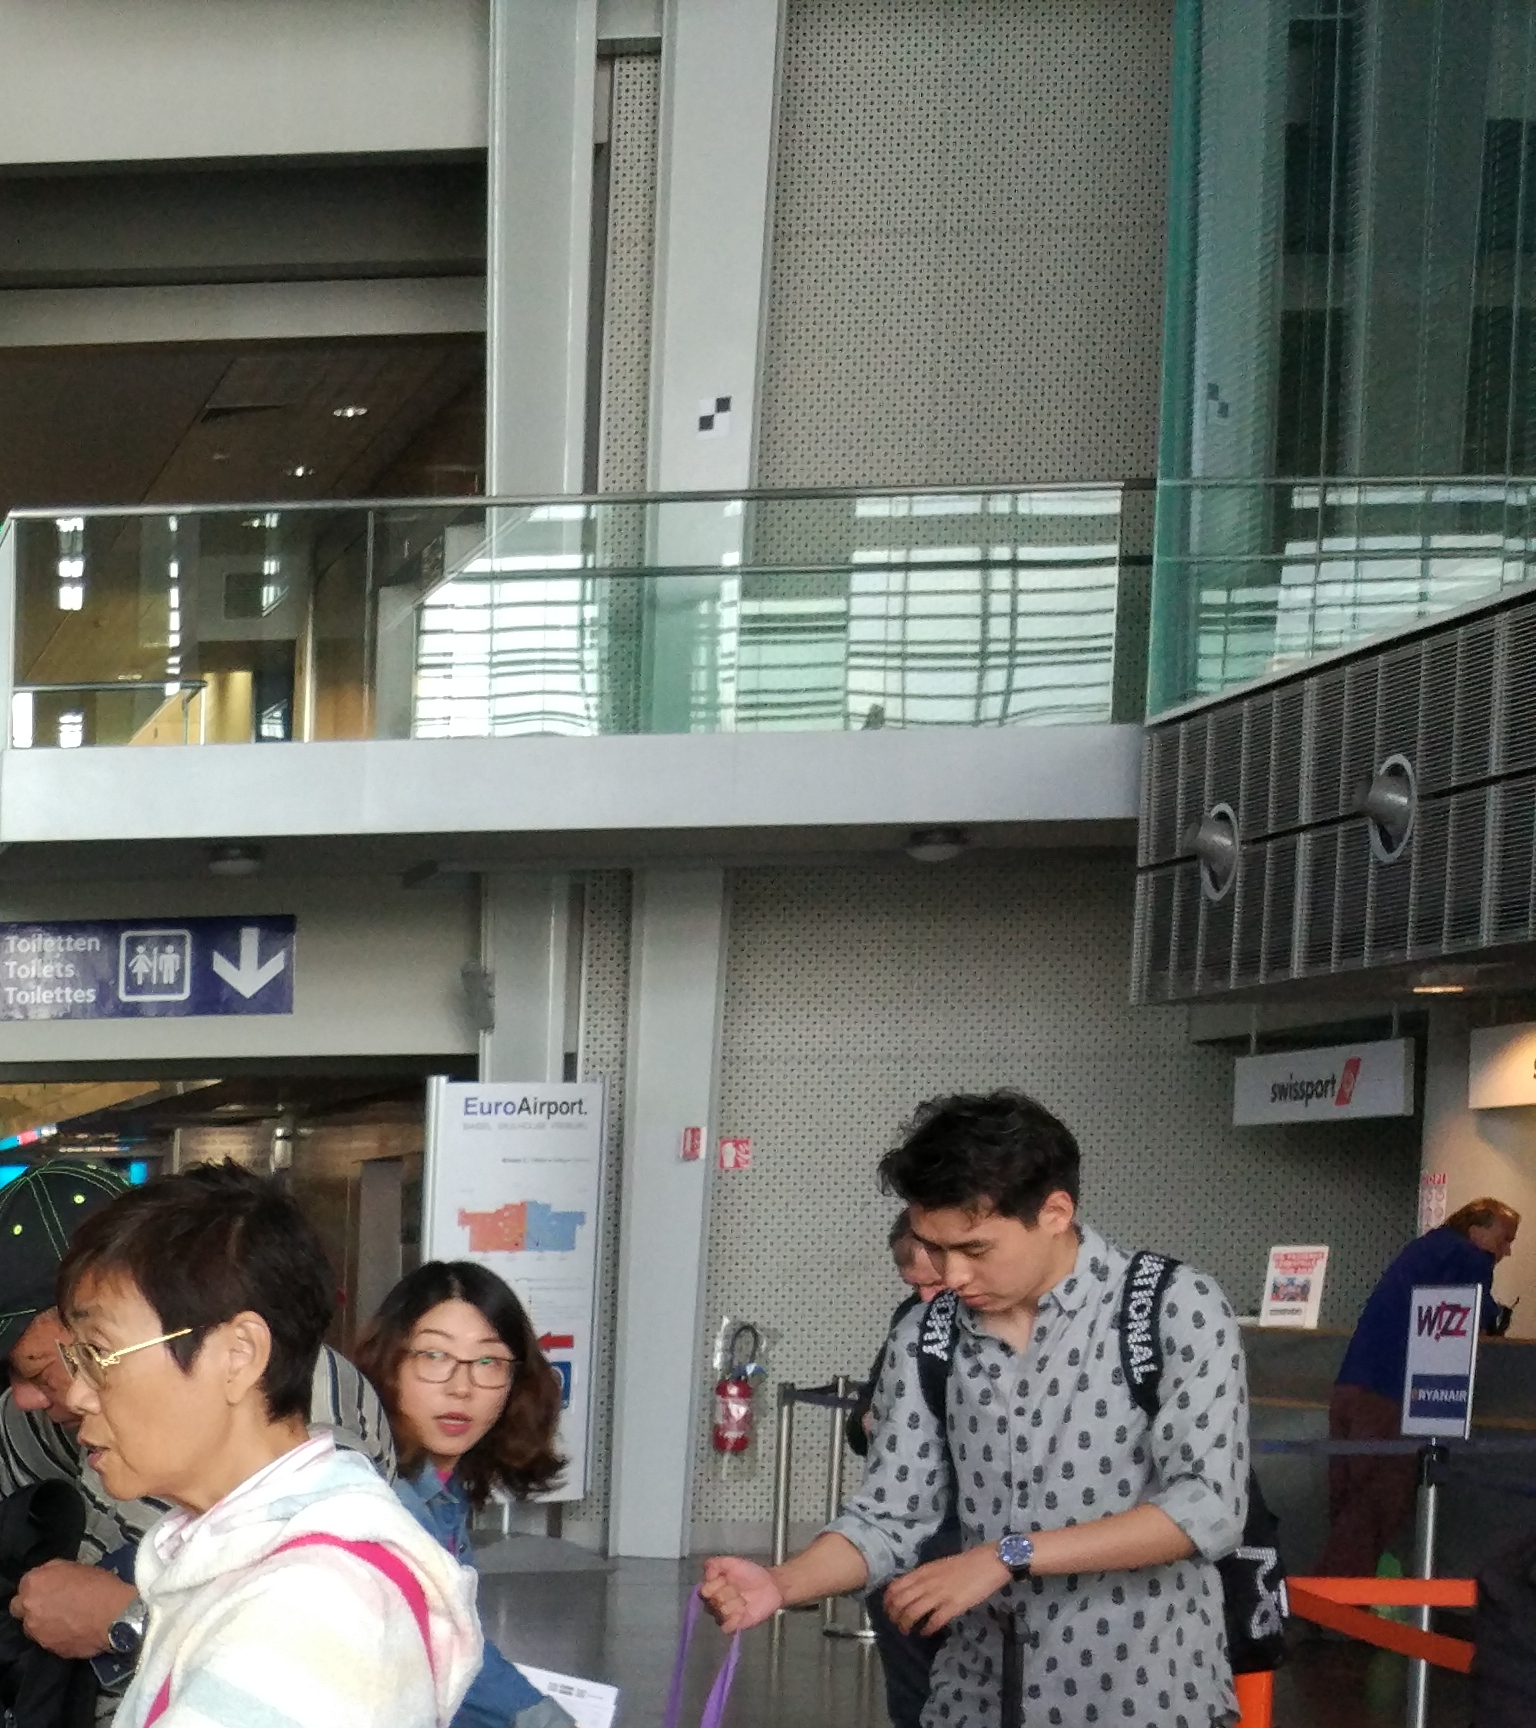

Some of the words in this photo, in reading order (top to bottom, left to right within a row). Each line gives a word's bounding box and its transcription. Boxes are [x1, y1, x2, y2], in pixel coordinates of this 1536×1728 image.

[4, 933, 100, 955] Toiletten
[4, 960, 76, 980] Toilets
[4, 985, 97, 1006] Toilettes
[1270, 1072, 1337, 1108] swissport
[463, 1096, 588, 1120] EuroAirport.
[1418, 1389, 1468, 1402] RYANAIR
